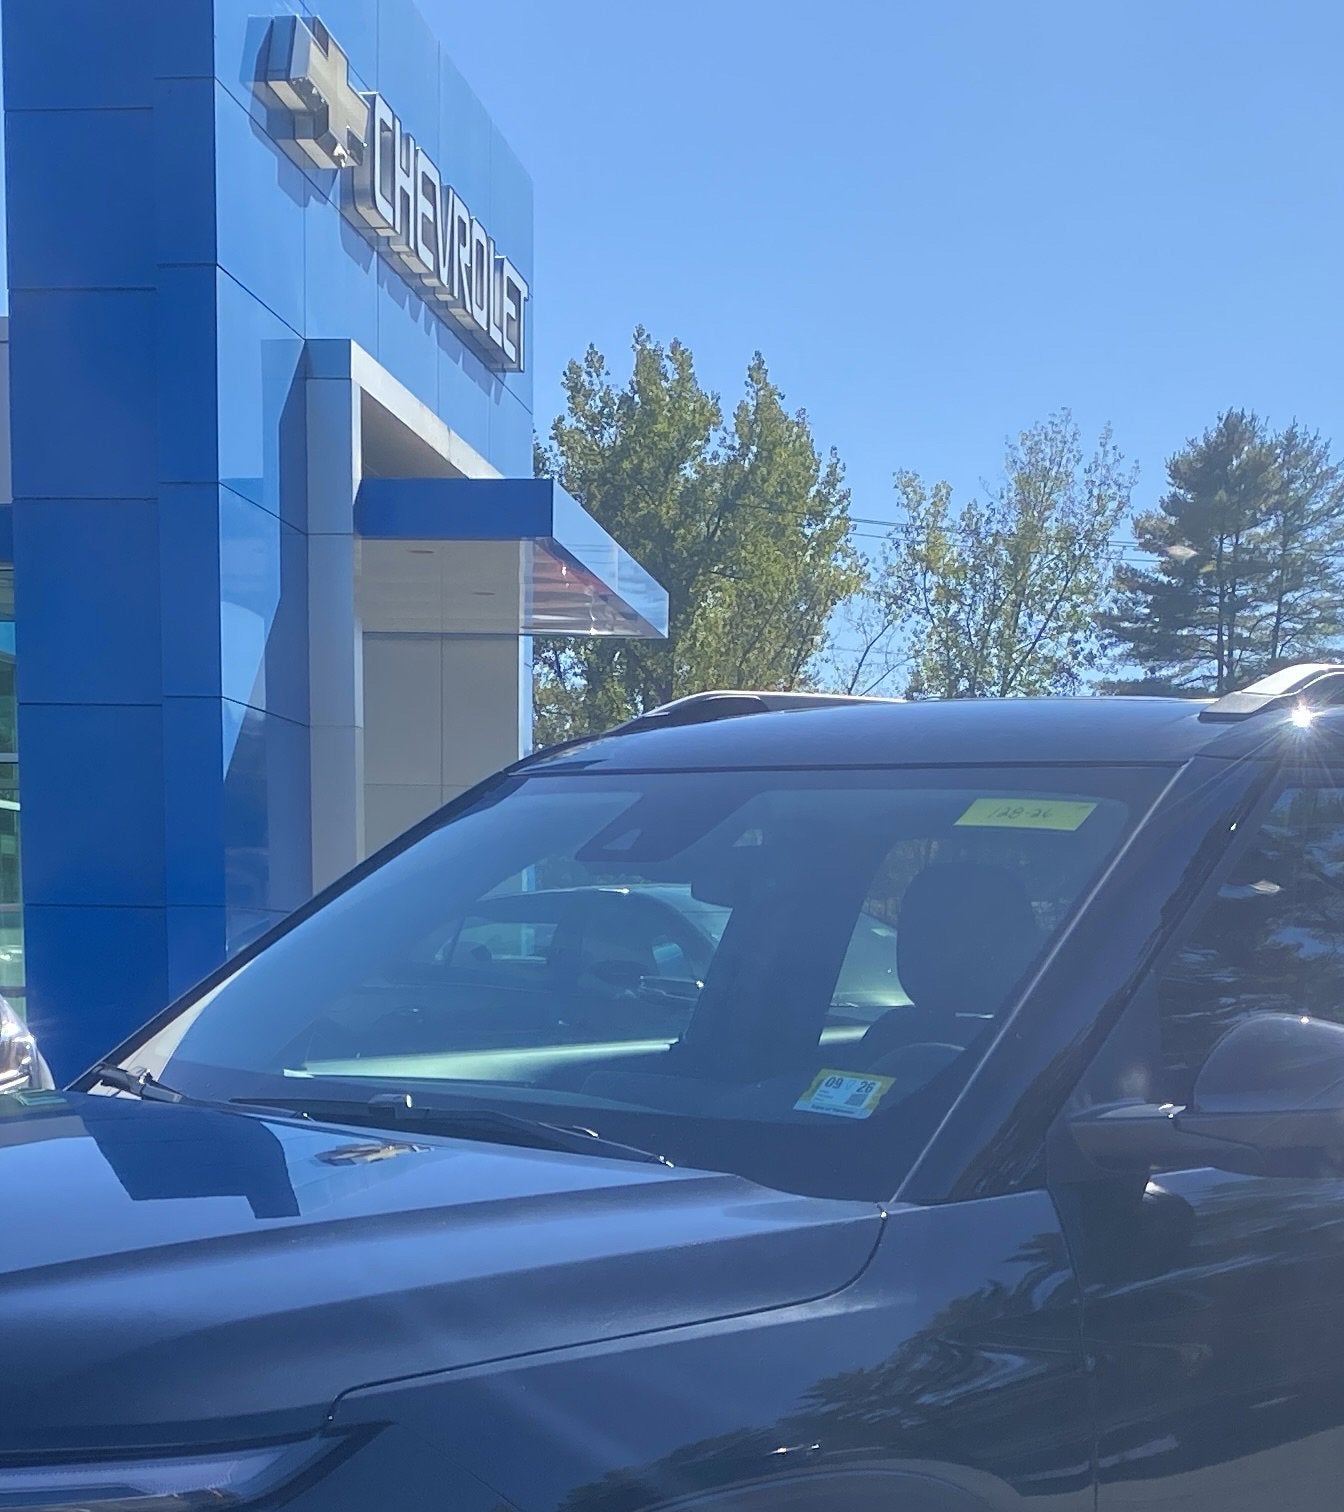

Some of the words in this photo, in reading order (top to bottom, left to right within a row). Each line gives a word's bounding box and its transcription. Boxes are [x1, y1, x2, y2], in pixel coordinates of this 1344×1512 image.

[370, 92, 529, 372] CHEVROLET
[825, 1077, 843, 1089] 09
[856, 1082, 875, 1093] 26
